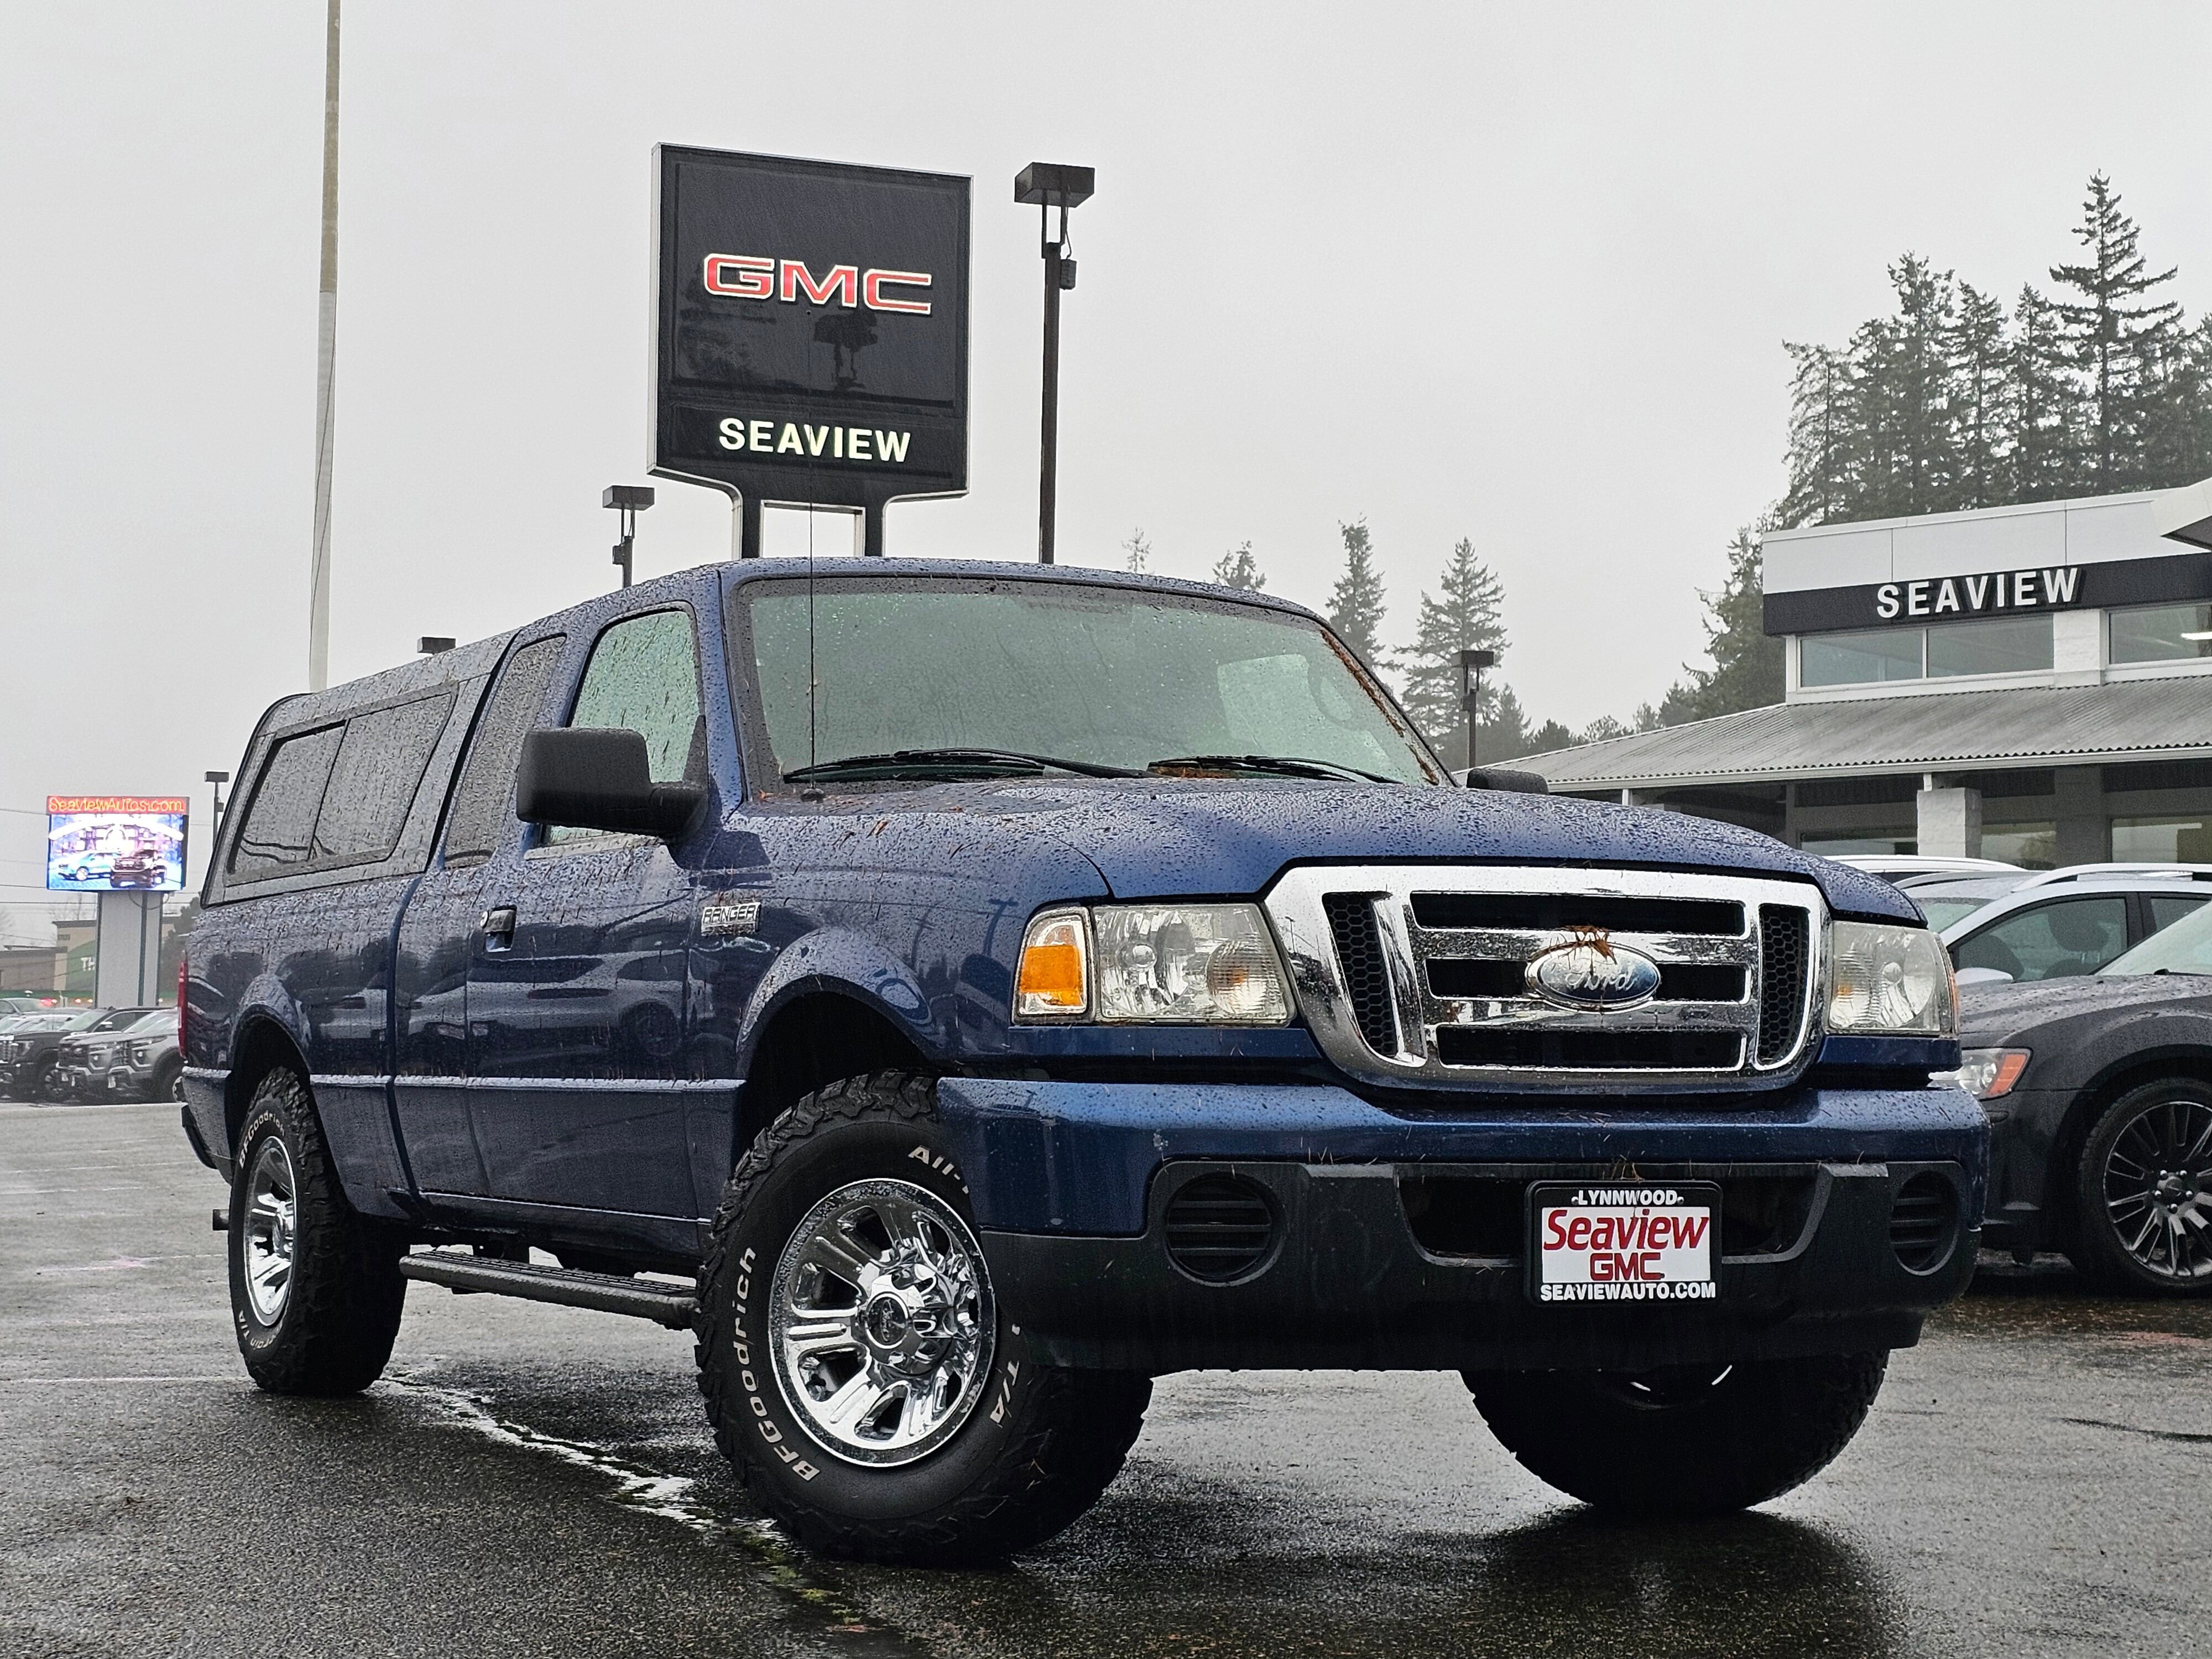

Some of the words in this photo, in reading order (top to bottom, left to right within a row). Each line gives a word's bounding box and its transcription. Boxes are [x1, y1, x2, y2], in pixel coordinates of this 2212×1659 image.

[704, 253, 932, 315] GMC
[719, 418, 911, 462] SEAVIEW
[1877, 568, 2078, 618] SEAVIEW
[703, 905, 755, 923] RANGER
[1564, 959, 1636, 992] Ford
[239, 1110, 285, 1169] BFGoodrich
[1578, 1190, 1678, 1206] LYNNWOOD
[1543, 1209, 1709, 1251] Seaview
[1590, 1252, 1661, 1281] GMC
[1540, 1282, 1716, 1301] SEAVIEWAUTO.COM
[732, 1247, 821, 1482] BFGoodrich
[990, 1359, 1020, 1423] T/A
